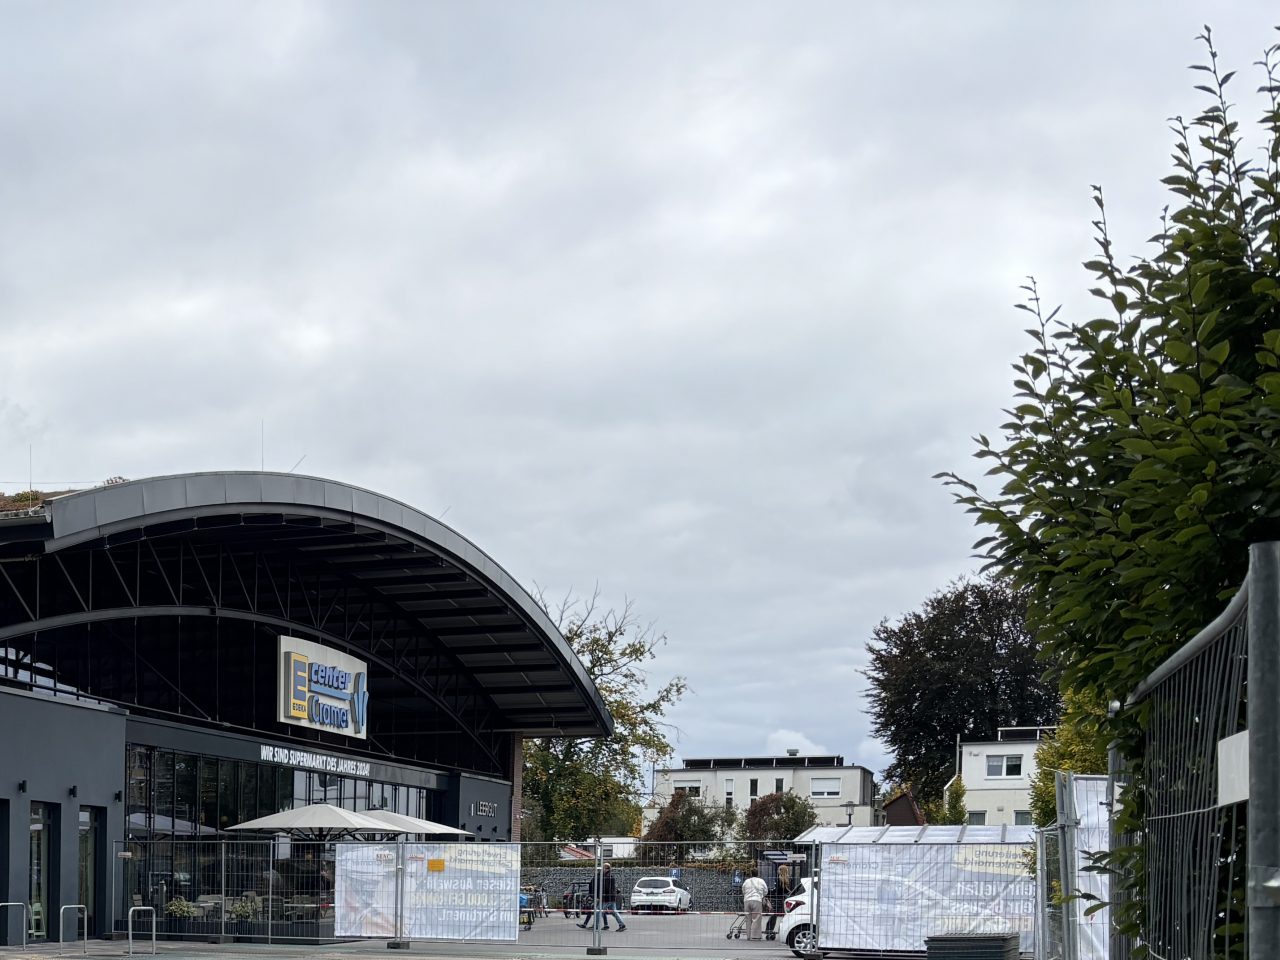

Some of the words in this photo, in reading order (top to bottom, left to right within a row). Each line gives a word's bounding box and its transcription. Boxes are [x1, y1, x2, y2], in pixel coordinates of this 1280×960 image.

[293, 660, 307, 702] E
[310, 663, 352, 690] center
[292, 702, 307, 713] EDEKA
[260, 744, 273, 761] WIR
[274, 748, 289, 764] SIND
[289, 750, 326, 770] SUPERMARKT
[326, 756, 337, 772] DES
[337, 758, 356, 775] JAHRES
[477, 801, 498, 818] LEERGUT
